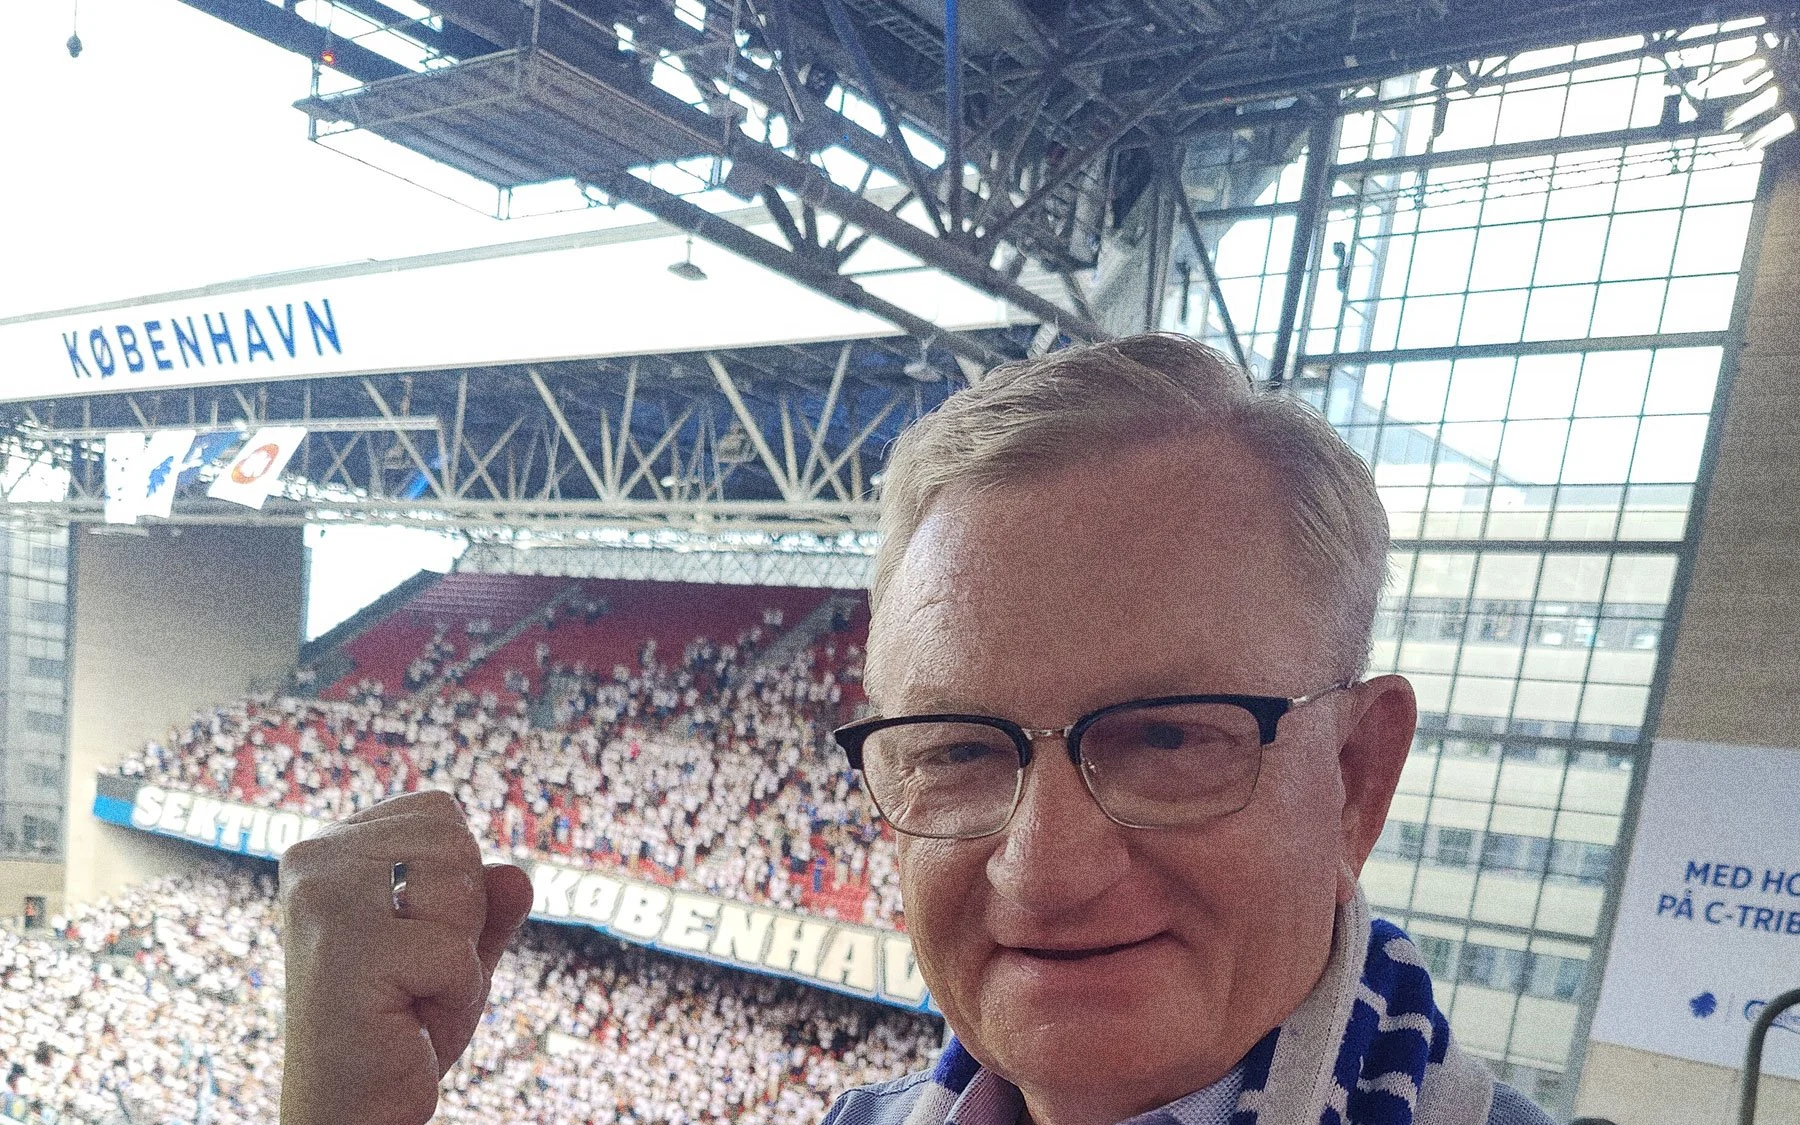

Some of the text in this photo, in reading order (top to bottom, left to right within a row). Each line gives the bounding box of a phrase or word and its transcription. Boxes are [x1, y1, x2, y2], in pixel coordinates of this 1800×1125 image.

[63, 299, 342, 378] KØBENHAVN
[1685, 860, 1752, 889] MED
[1657, 888, 1692, 920] PÅ
[529, 863, 941, 1011] KØBENHAV
